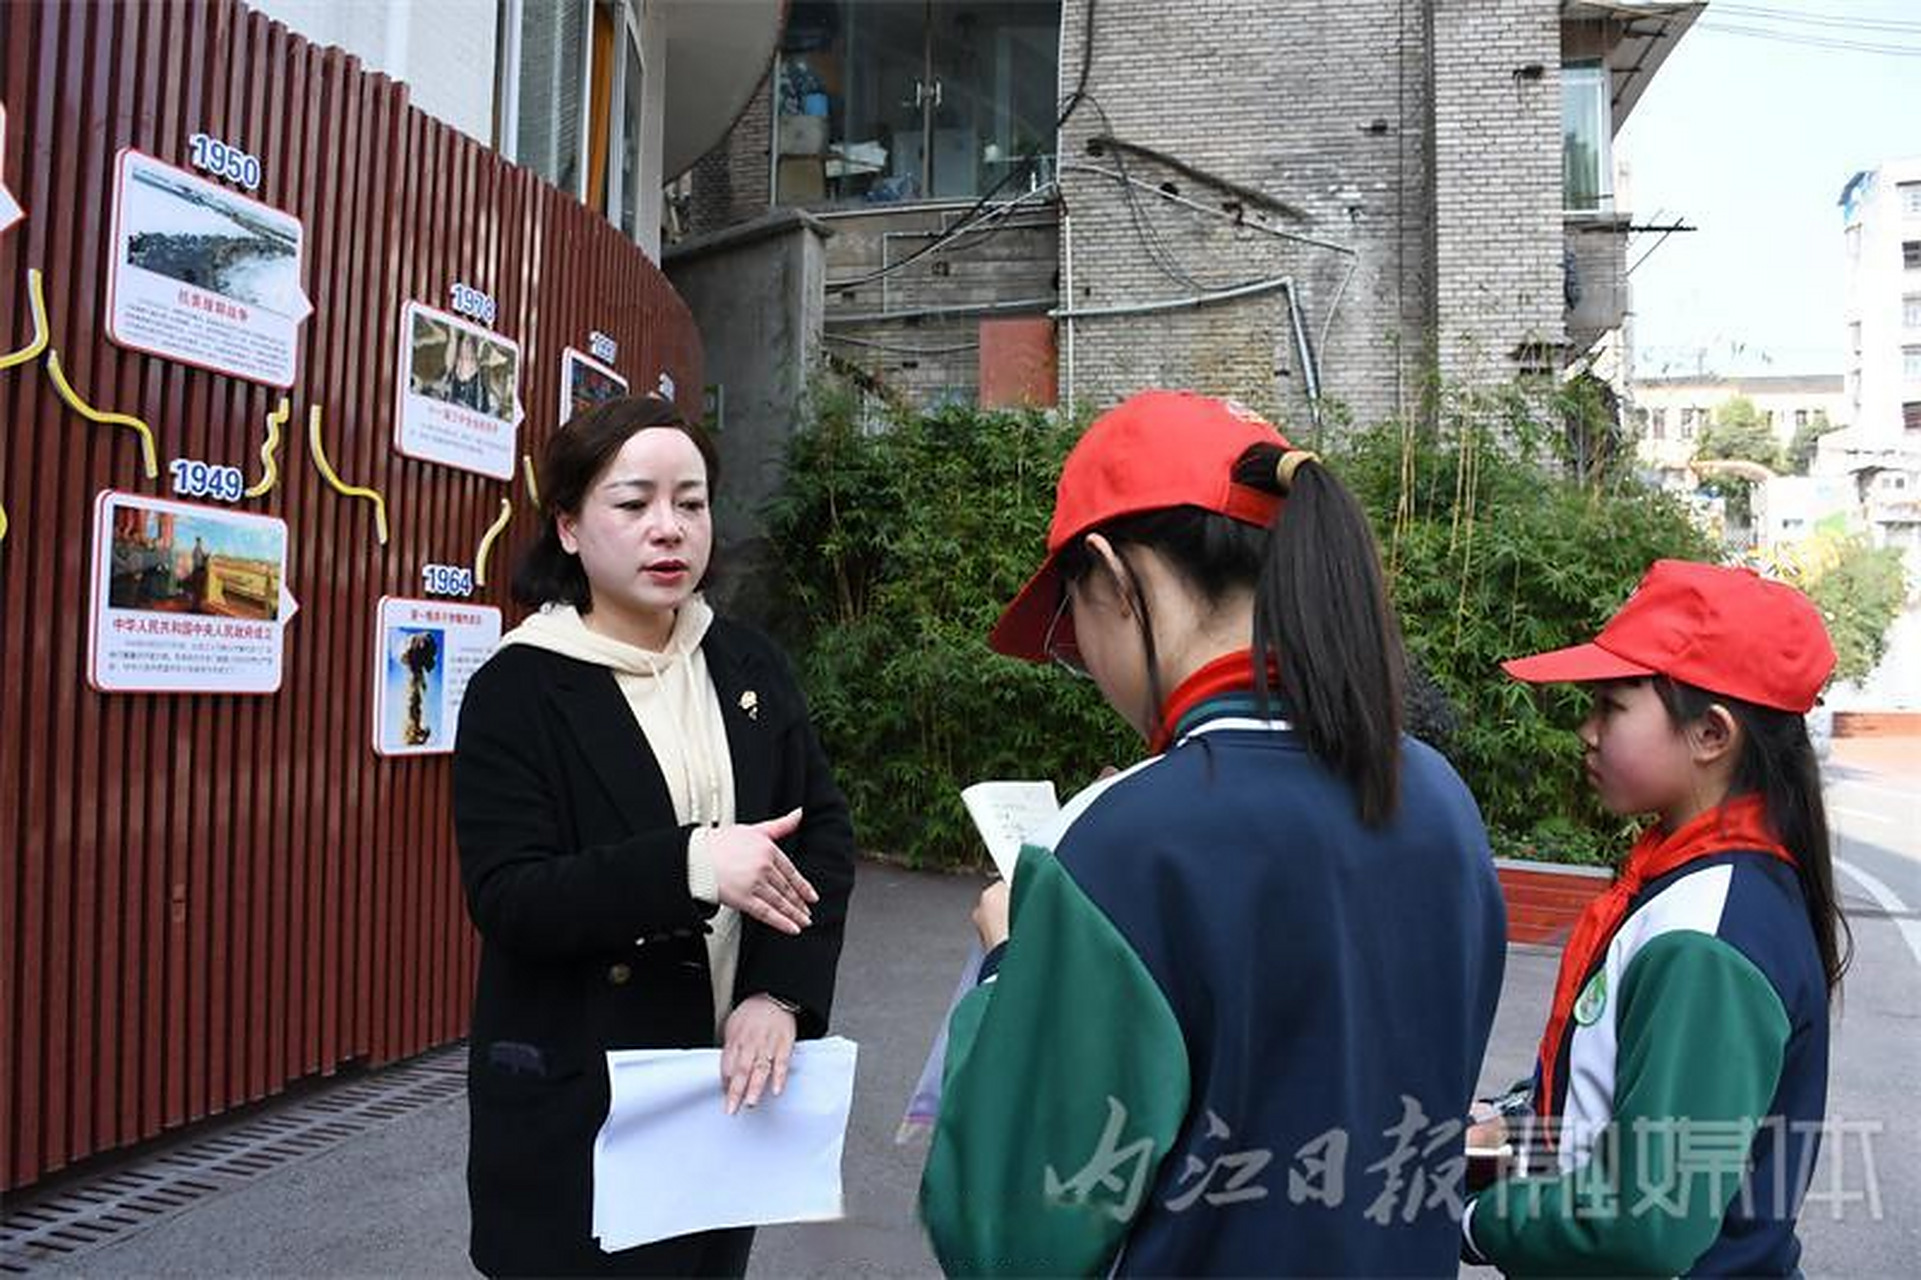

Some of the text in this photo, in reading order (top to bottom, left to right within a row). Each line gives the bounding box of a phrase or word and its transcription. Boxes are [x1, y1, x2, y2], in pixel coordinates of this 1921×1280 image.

[192, 135, 259, 188] 1950
[173, 460, 241, 499] 1949
[425, 565, 471, 594] 1964
[113, 618, 273, 640] 中华人民共和国中央人民政府成立
